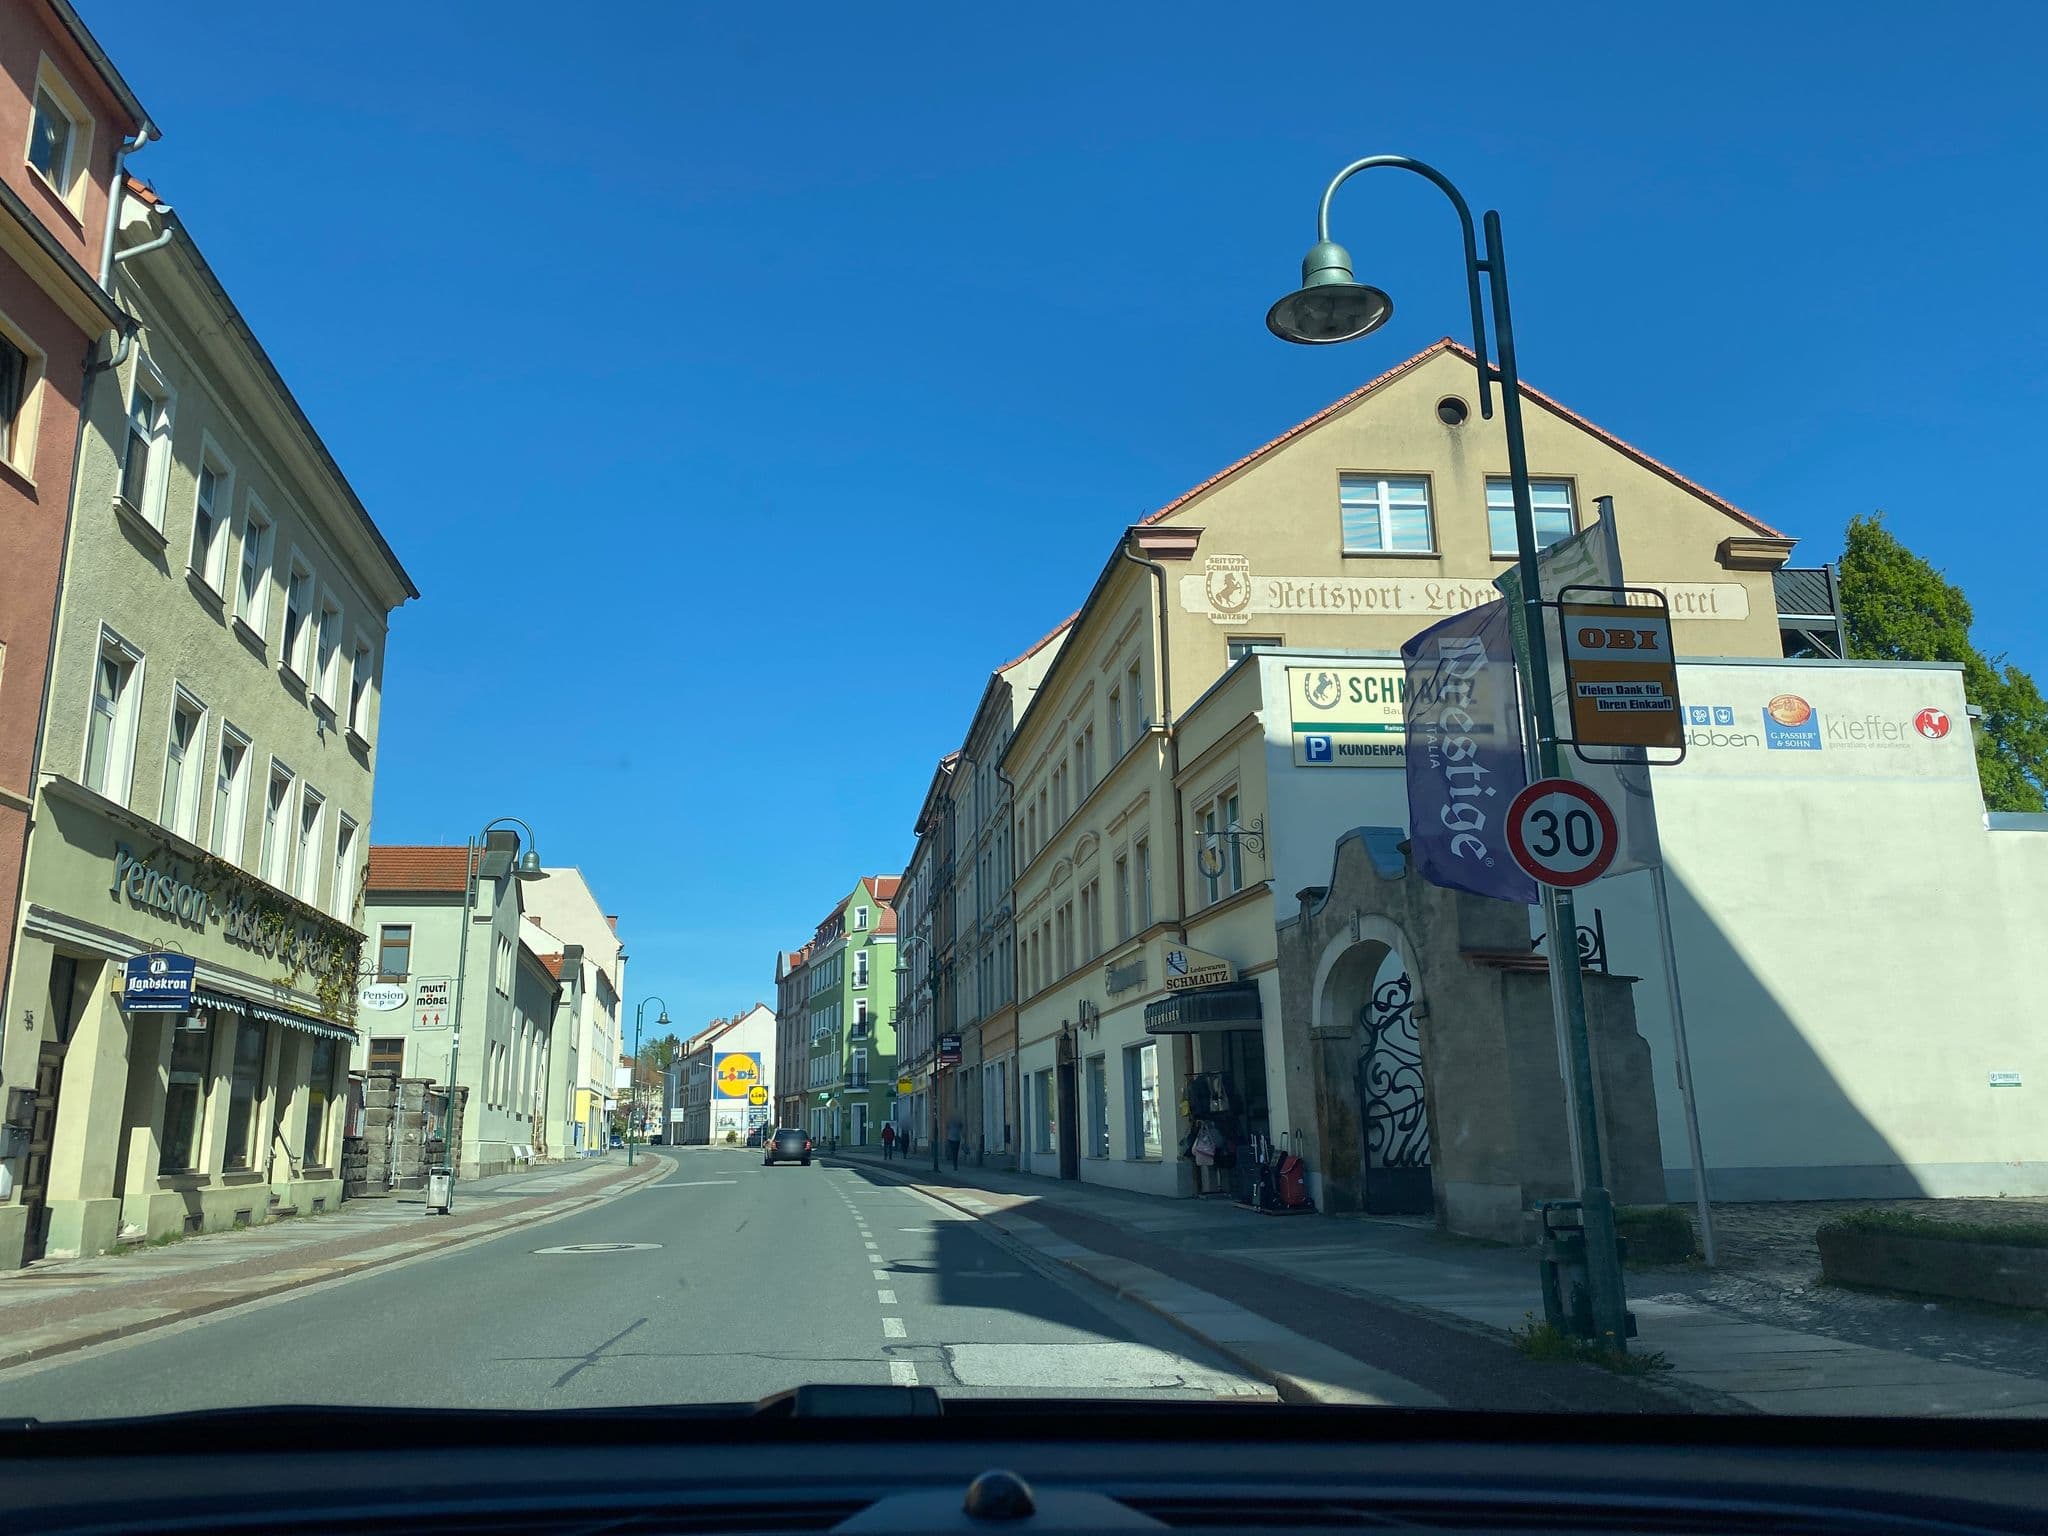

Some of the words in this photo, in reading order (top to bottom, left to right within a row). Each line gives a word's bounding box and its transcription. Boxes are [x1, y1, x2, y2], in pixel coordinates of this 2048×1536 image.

[1268, 581, 1402, 612] Reitsport
[1425, 583, 1497, 611] Leder
[1578, 628, 1658, 650] OBI
[1579, 684, 1614, 696] Vielen
[1615, 684, 1642, 696] Dank
[1645, 685, 1660, 696] für
[1599, 699, 1627, 711] Ihren
[1629, 699, 1671, 711] Einkauf!
[1825, 714, 1908, 741] kieffer
[1311, 738, 1327, 759] P
[1339, 744, 1405, 756] KUNDENPA
[1426, 721, 1441, 770] ITALIA
[1438, 636, 1497, 861] Prestige
[1785, 740, 1811, 748] SOHN
[1530, 810, 1596, 857] 30
[111, 844, 207, 928] Pension
[1190, 964, 1226, 973] Lederwaren
[127, 976, 187, 992] Landskron
[1166, 971, 1228, 990] SCHMAUTZ
[363, 990, 404, 1000] Pension
[416, 994, 448, 1006] MÖBEL
